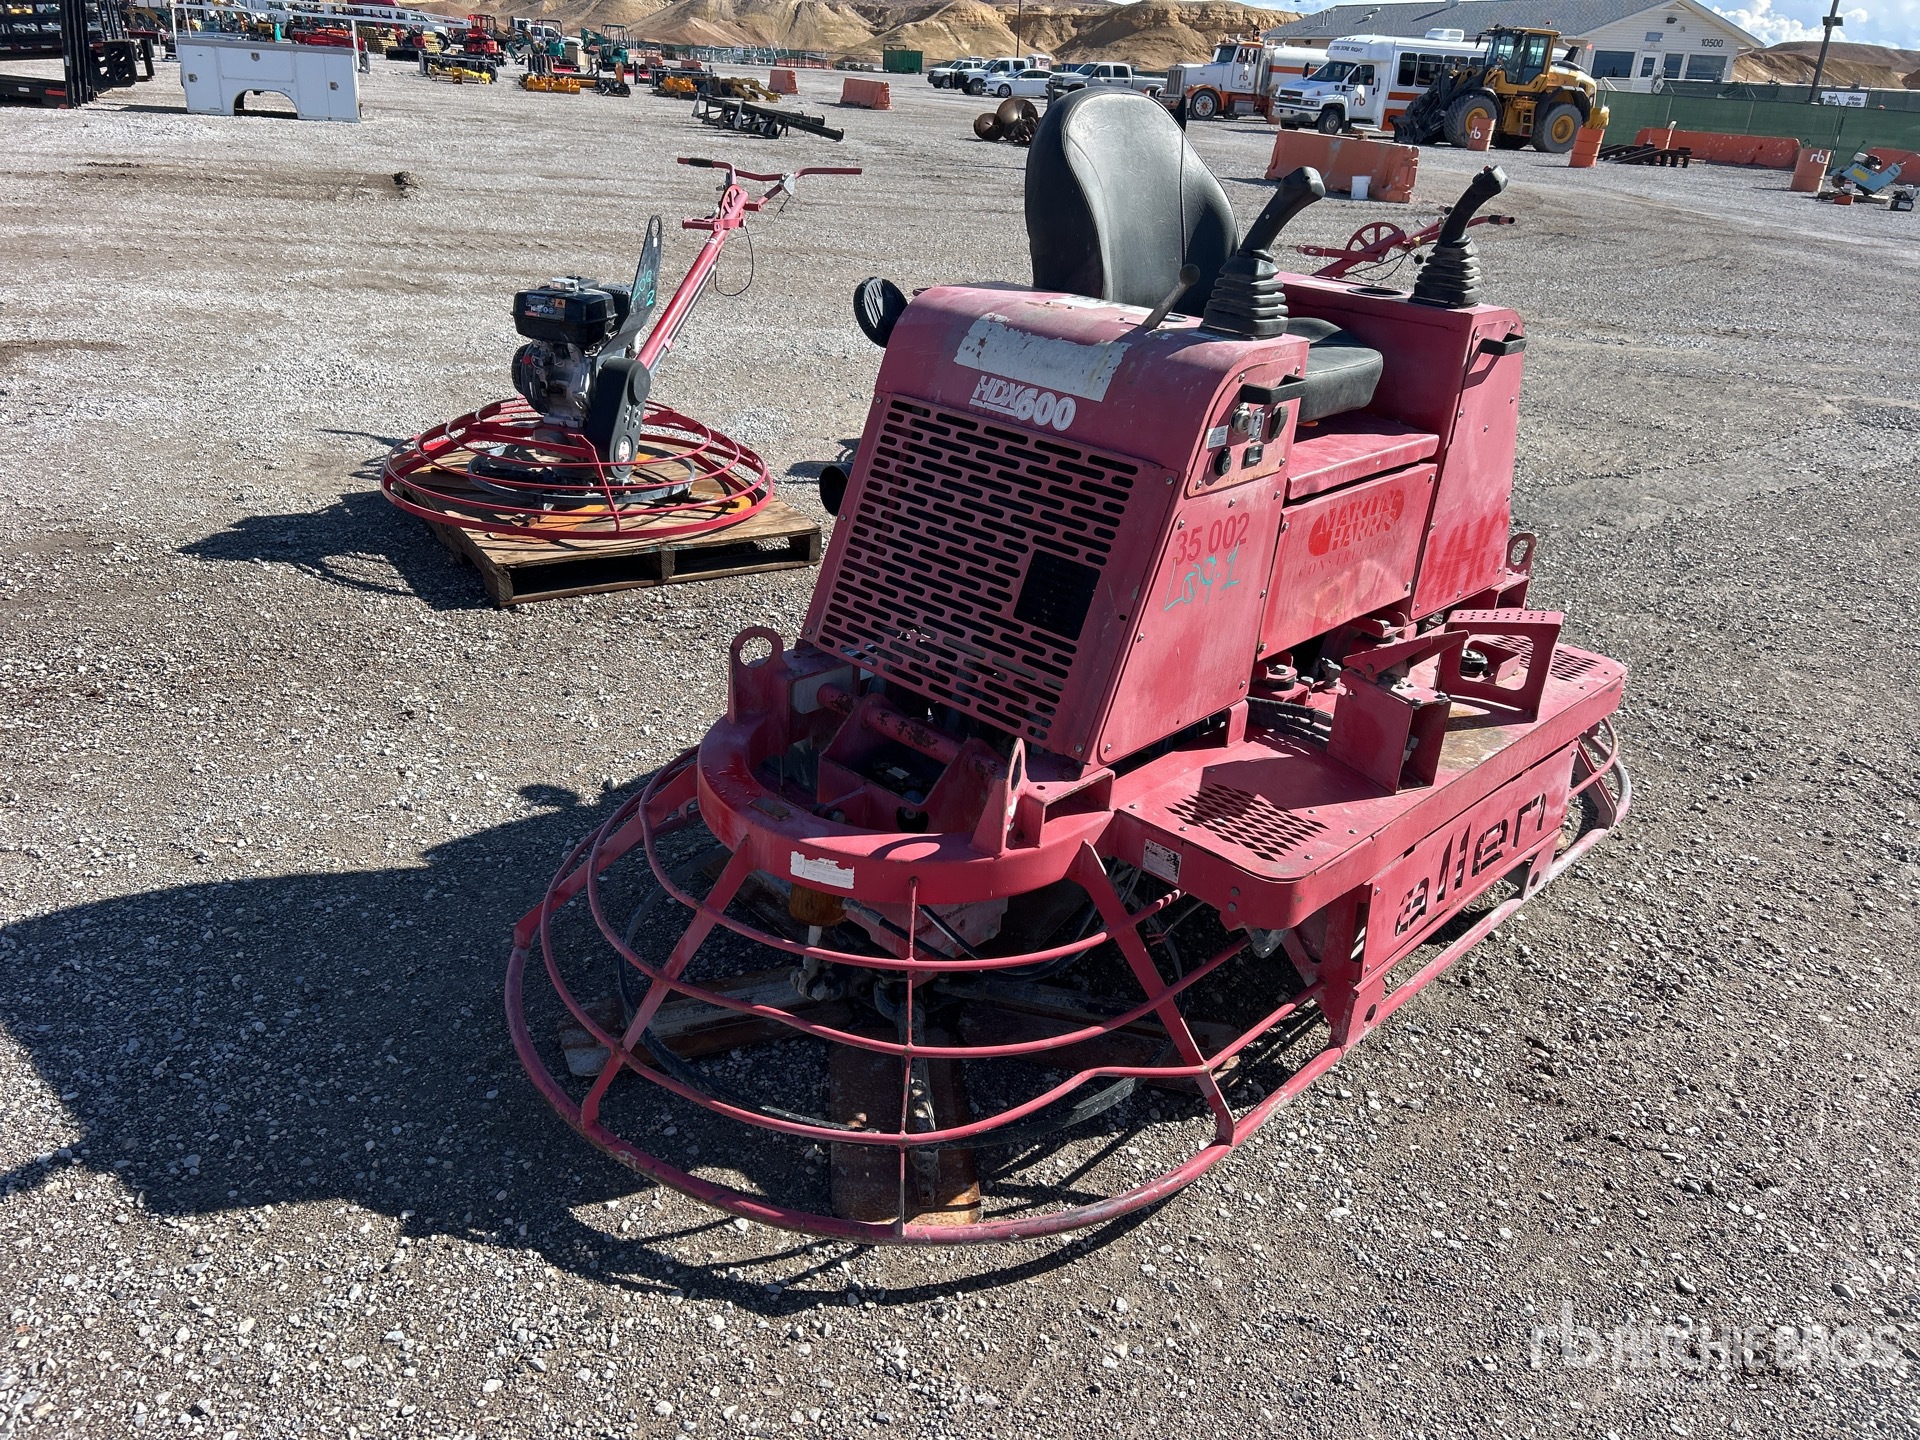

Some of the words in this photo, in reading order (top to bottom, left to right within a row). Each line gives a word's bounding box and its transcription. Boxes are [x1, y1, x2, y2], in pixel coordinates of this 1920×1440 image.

[1701, 38, 1724, 48] 10500
[1238, 70, 1249, 81] rb
[1354, 94, 1366, 107] rb
[1470, 126, 1482, 140] rb
[1809, 149, 1826, 164] rb
[645, 288, 656, 307] 2
[969, 375, 1077, 432] HDX600
[1173, 525, 1203, 566] 35
[1208, 511, 1250, 555] 002
[1328, 516, 1395, 552] HARRIS
[1394, 792, 1547, 937] allen
